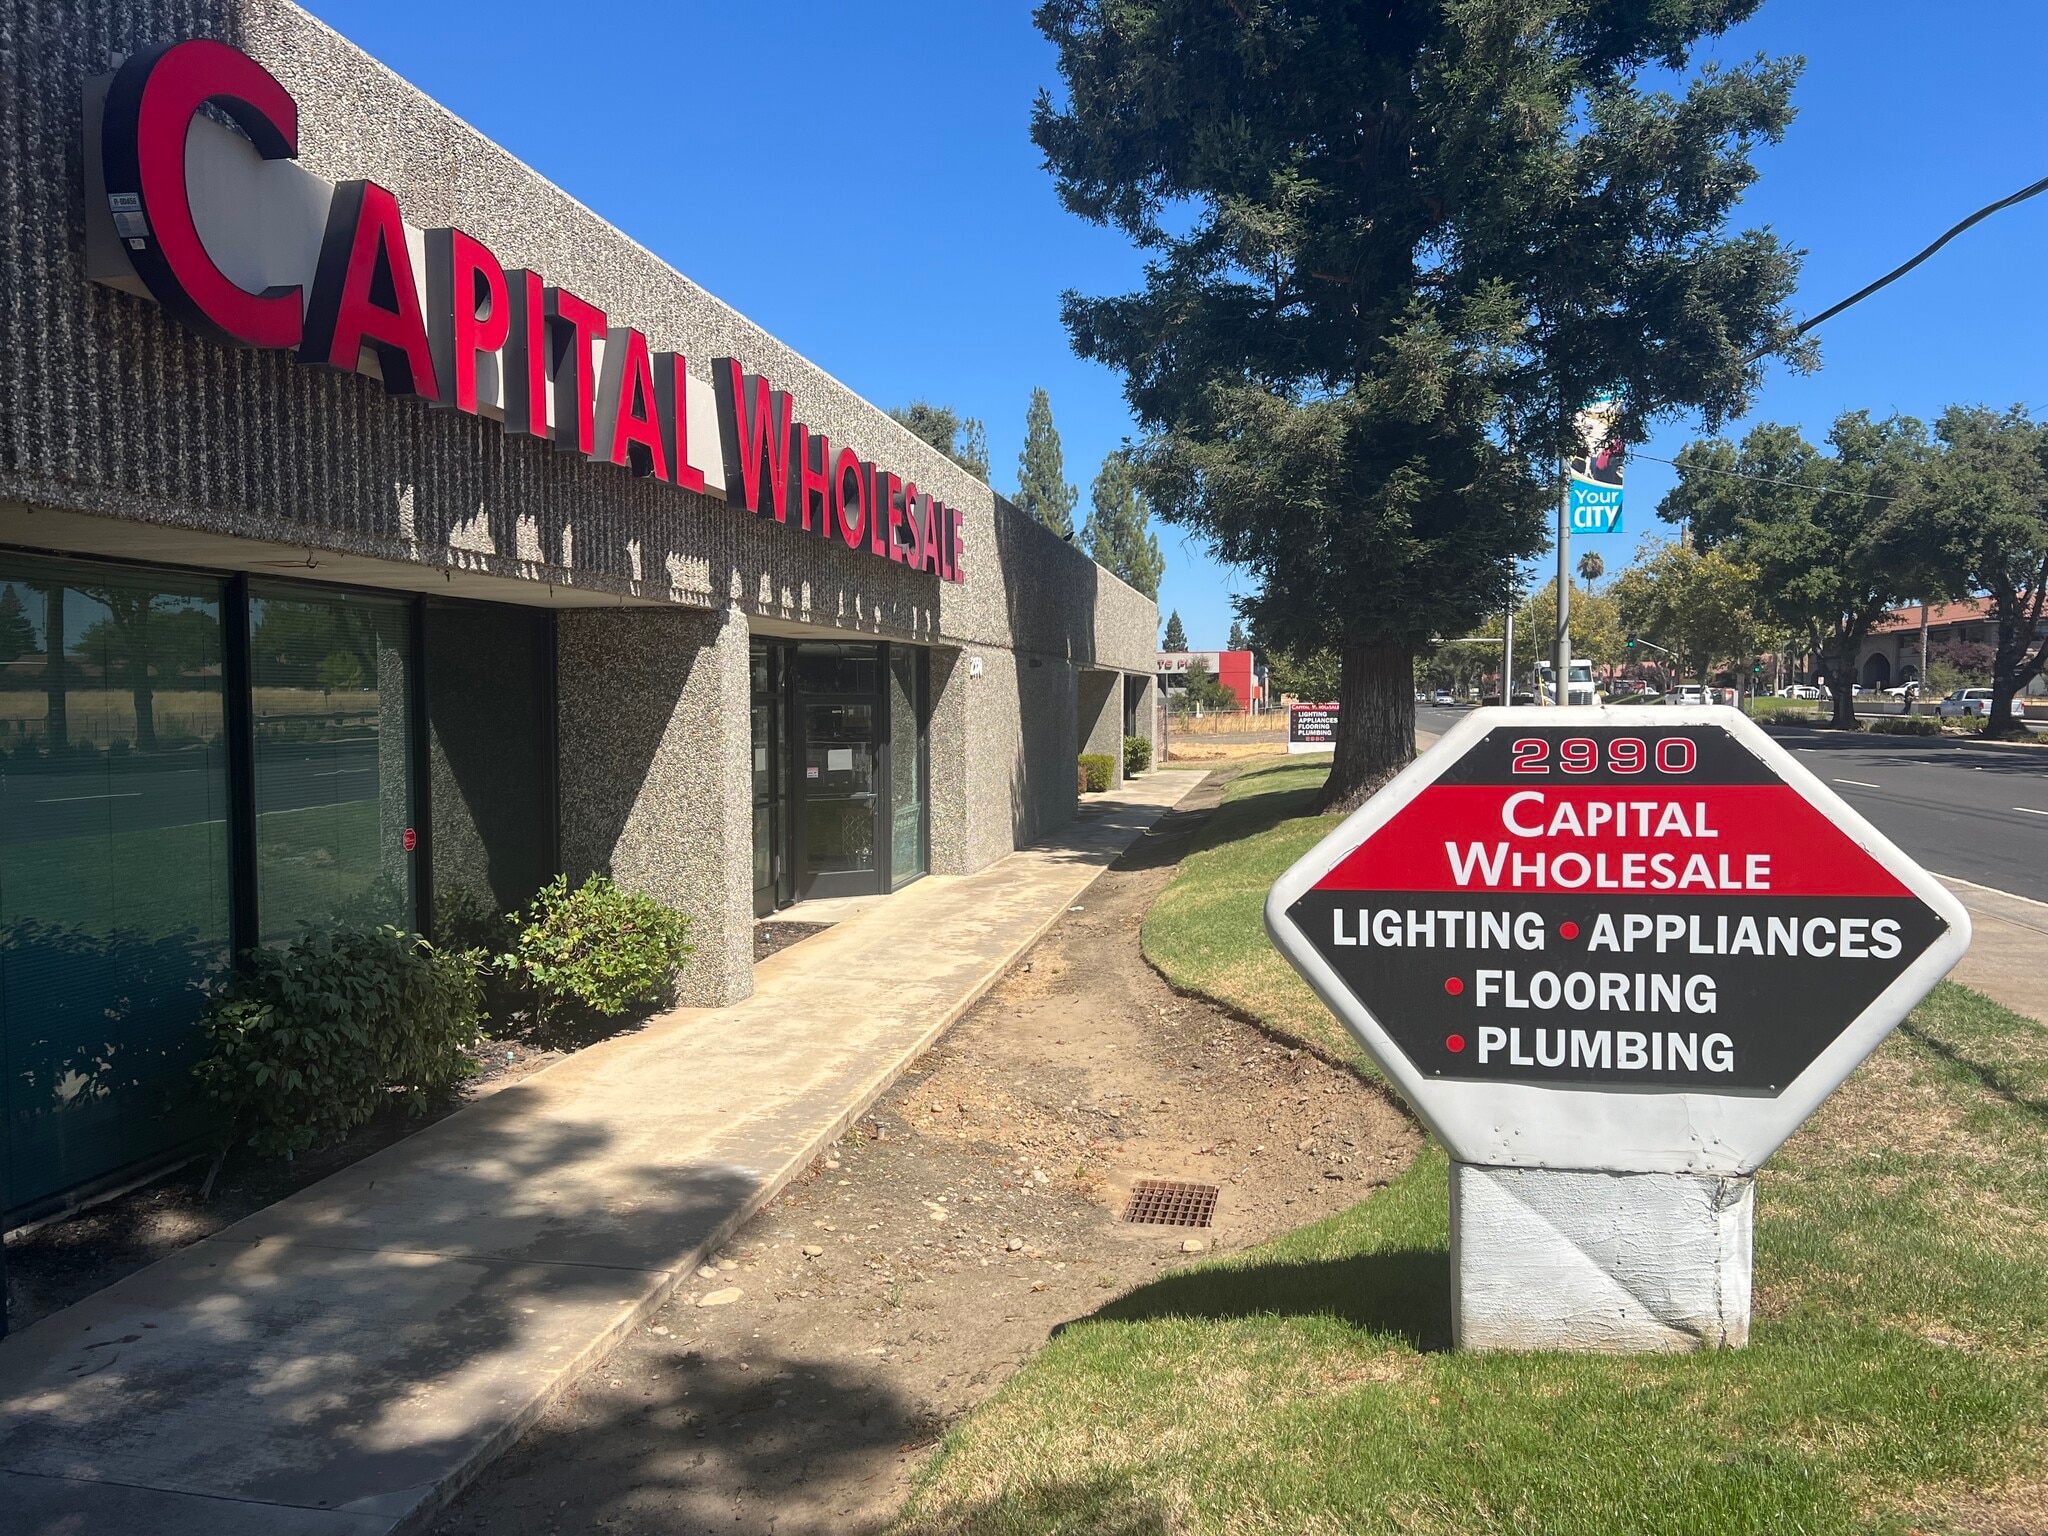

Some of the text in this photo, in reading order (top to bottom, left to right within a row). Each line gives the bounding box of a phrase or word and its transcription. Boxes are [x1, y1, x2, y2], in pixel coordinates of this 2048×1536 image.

[105, 38, 964, 583] CAPITAL WHOLESALE
[1574, 506, 1618, 528] CITY
[1575, 490, 1619, 504] Your
[1511, 737, 1697, 775] 2990
[1501, 790, 1719, 838] CAPITAL
[1445, 841, 1771, 890] WHOLESALE
[1333, 908, 1902, 959] LIGHTING APPLIANCES
[1476, 969, 1717, 1014] FLOORING
[1478, 1026, 1735, 1073] PLUMBING
